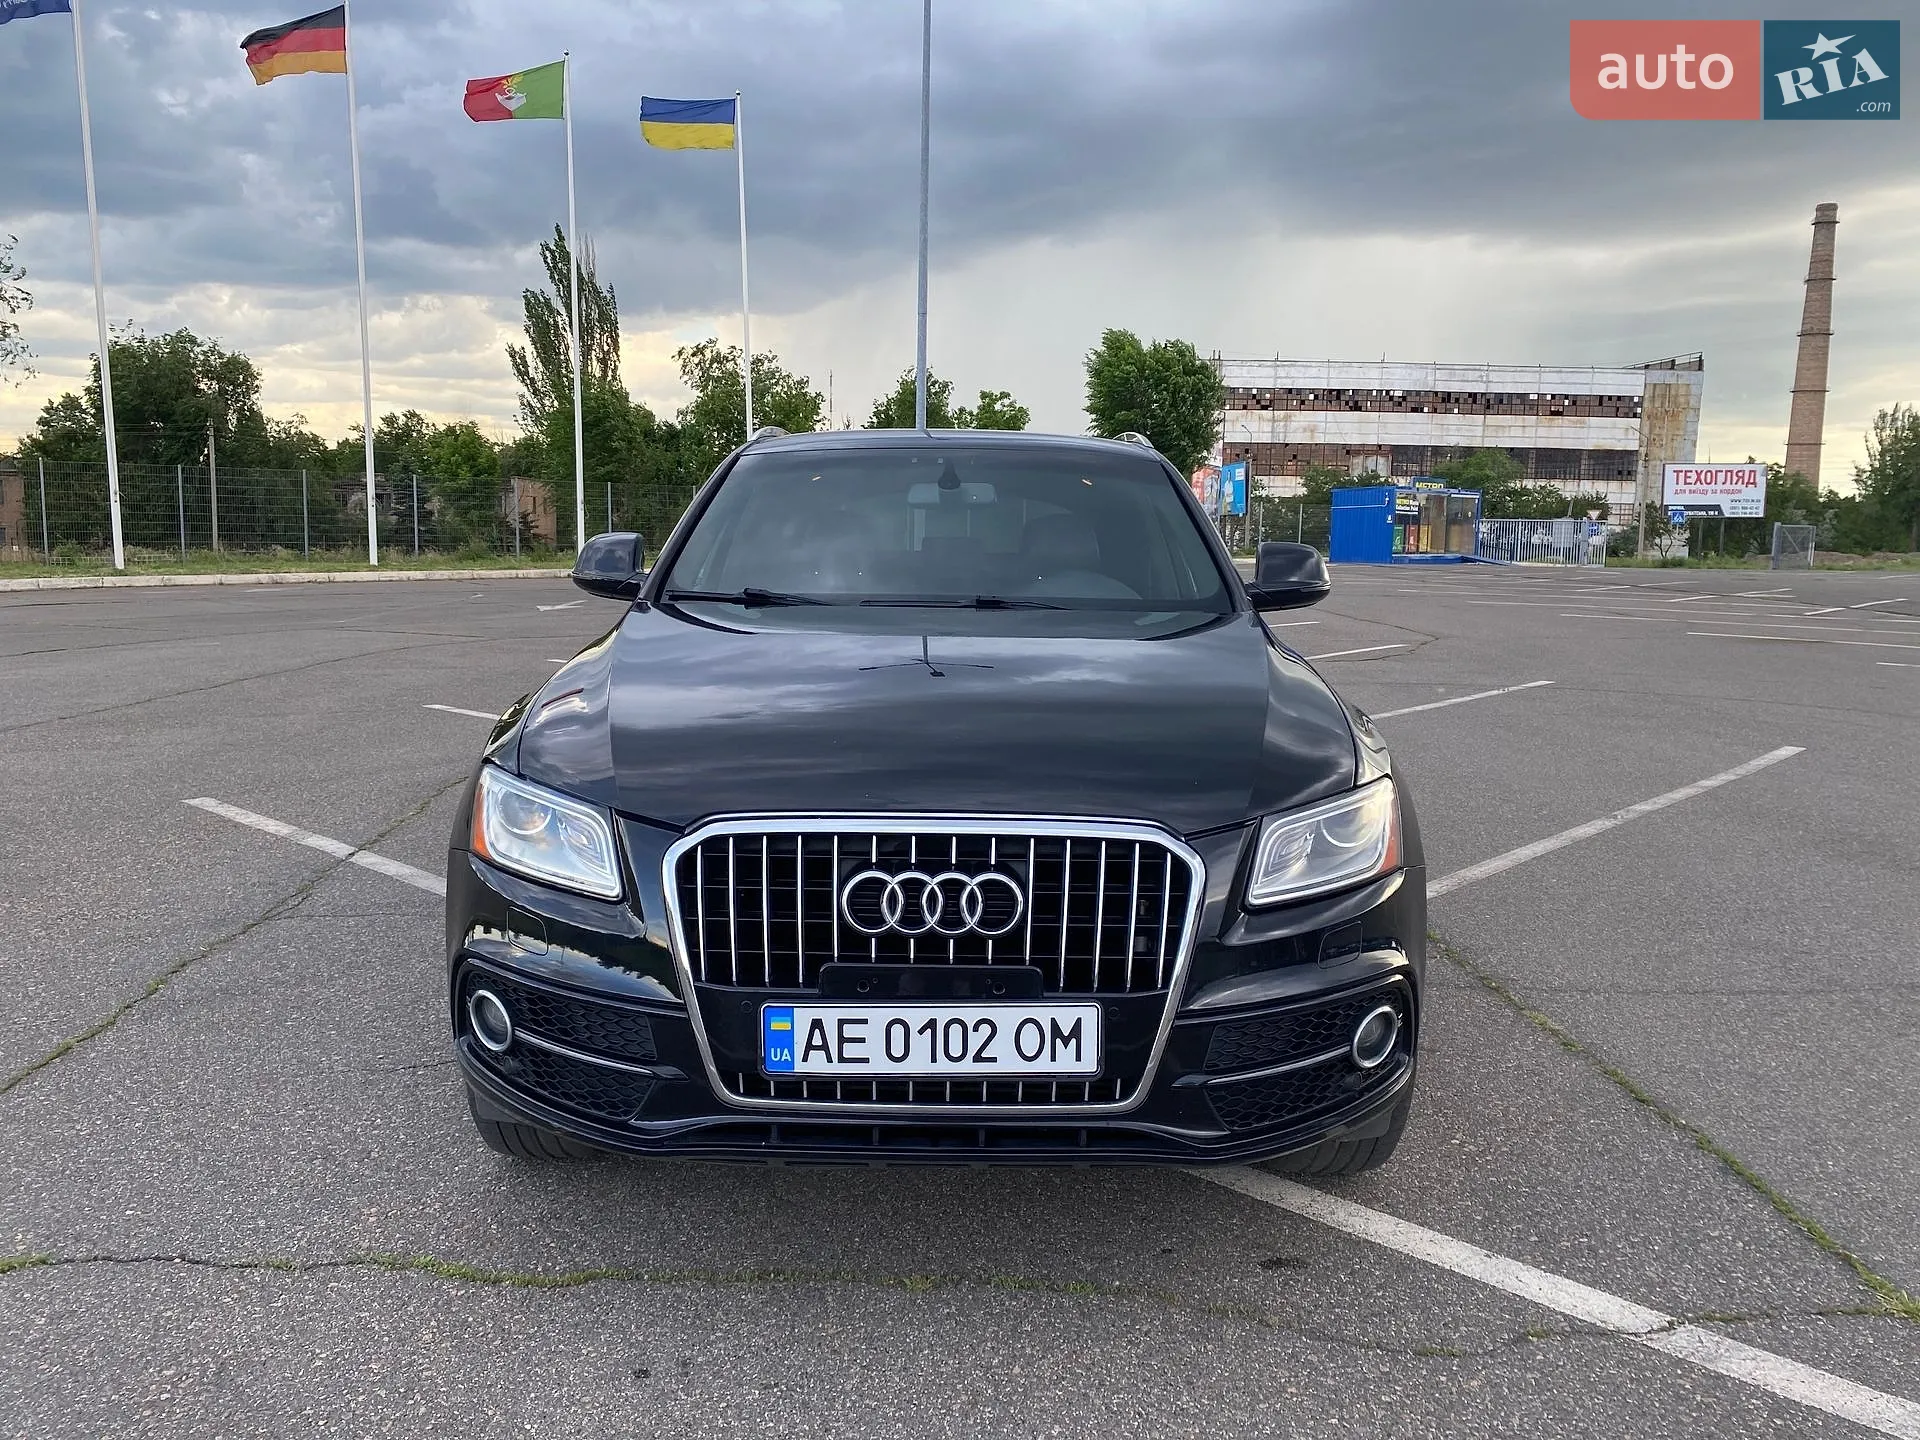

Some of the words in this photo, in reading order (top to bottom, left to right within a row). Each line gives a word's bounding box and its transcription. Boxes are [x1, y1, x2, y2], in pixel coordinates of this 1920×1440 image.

[1673, 469, 1758, 488] ТЕХОГЛЯД
[1673, 488, 1687, 496] для
[801, 1018, 870, 1064] AE
[885, 1017, 998, 1064] 0102
[1014, 1017, 1083, 1063] OM
[771, 1048, 792, 1062] UA
